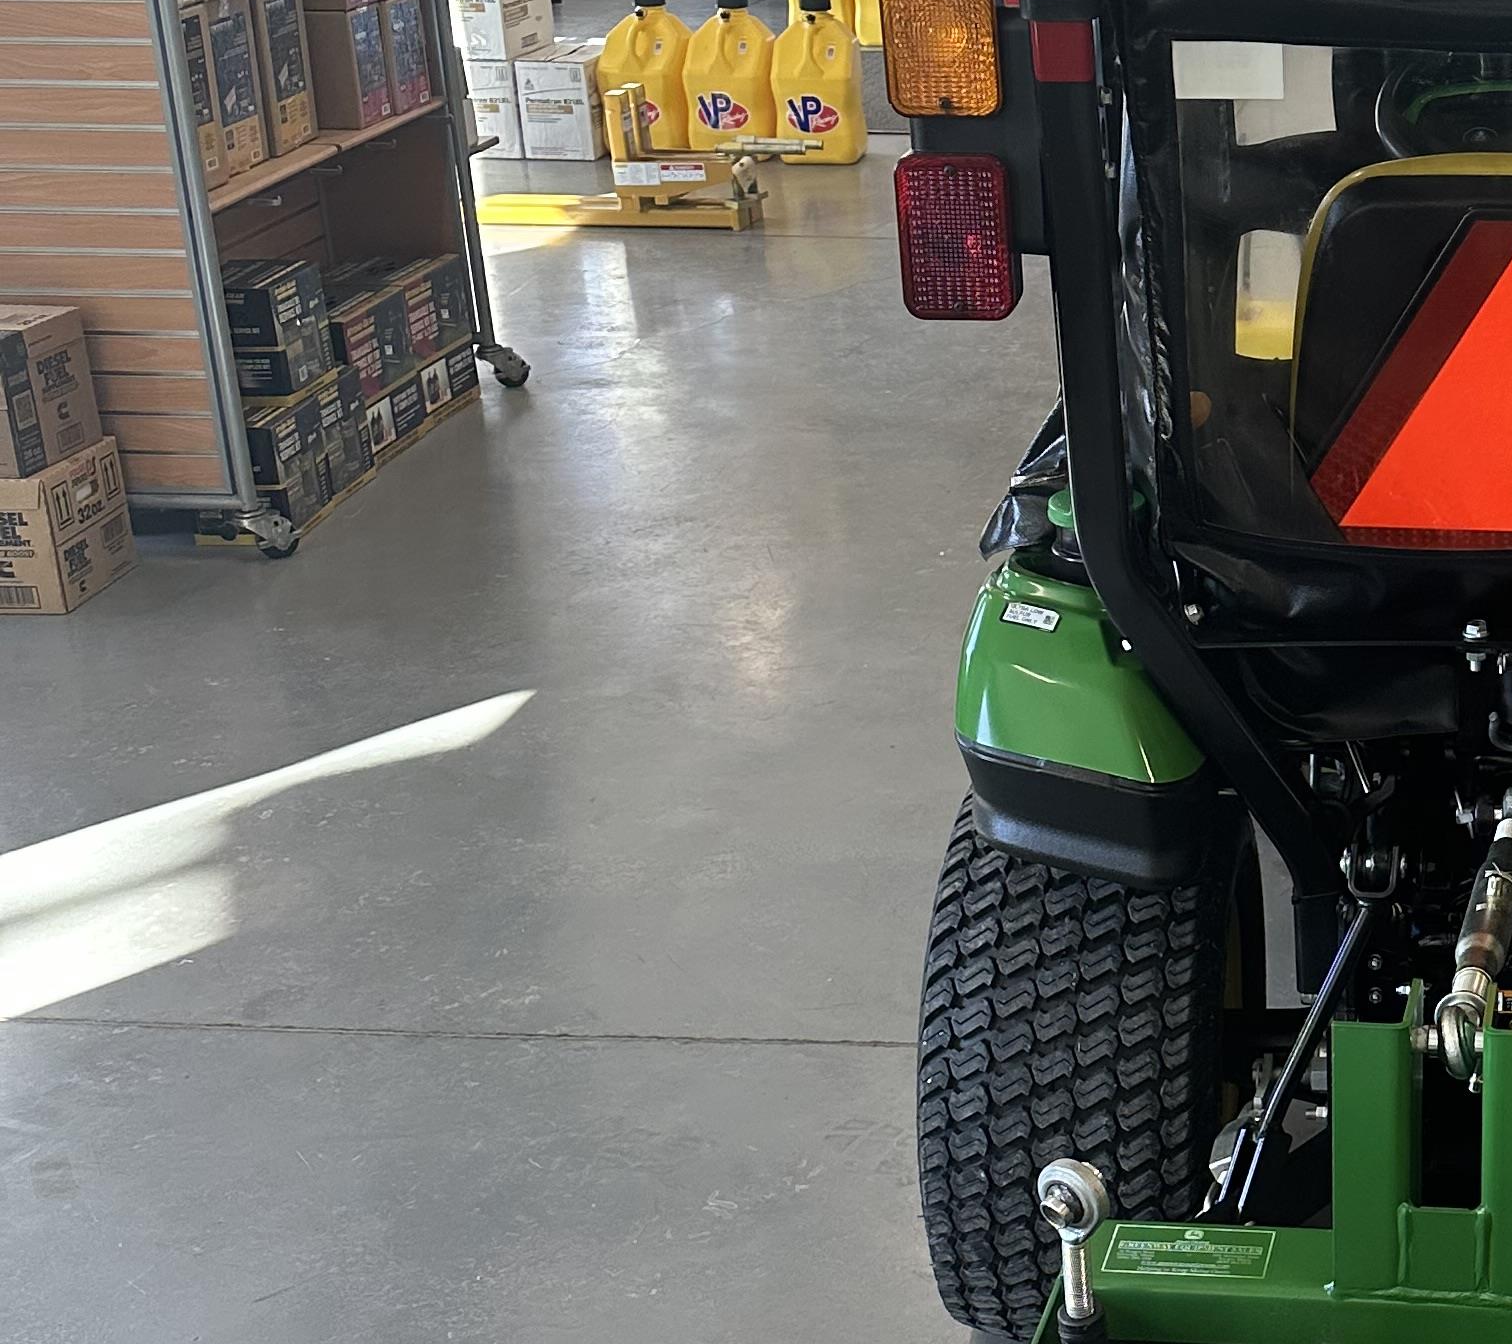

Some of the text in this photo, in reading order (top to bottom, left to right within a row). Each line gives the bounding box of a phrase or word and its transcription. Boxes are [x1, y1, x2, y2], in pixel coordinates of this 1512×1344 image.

[697, 91, 732, 130] VP
[786, 95, 822, 133] VP
[36, 349, 72, 376] DIESEL
[44, 365, 70, 387] FUEL
